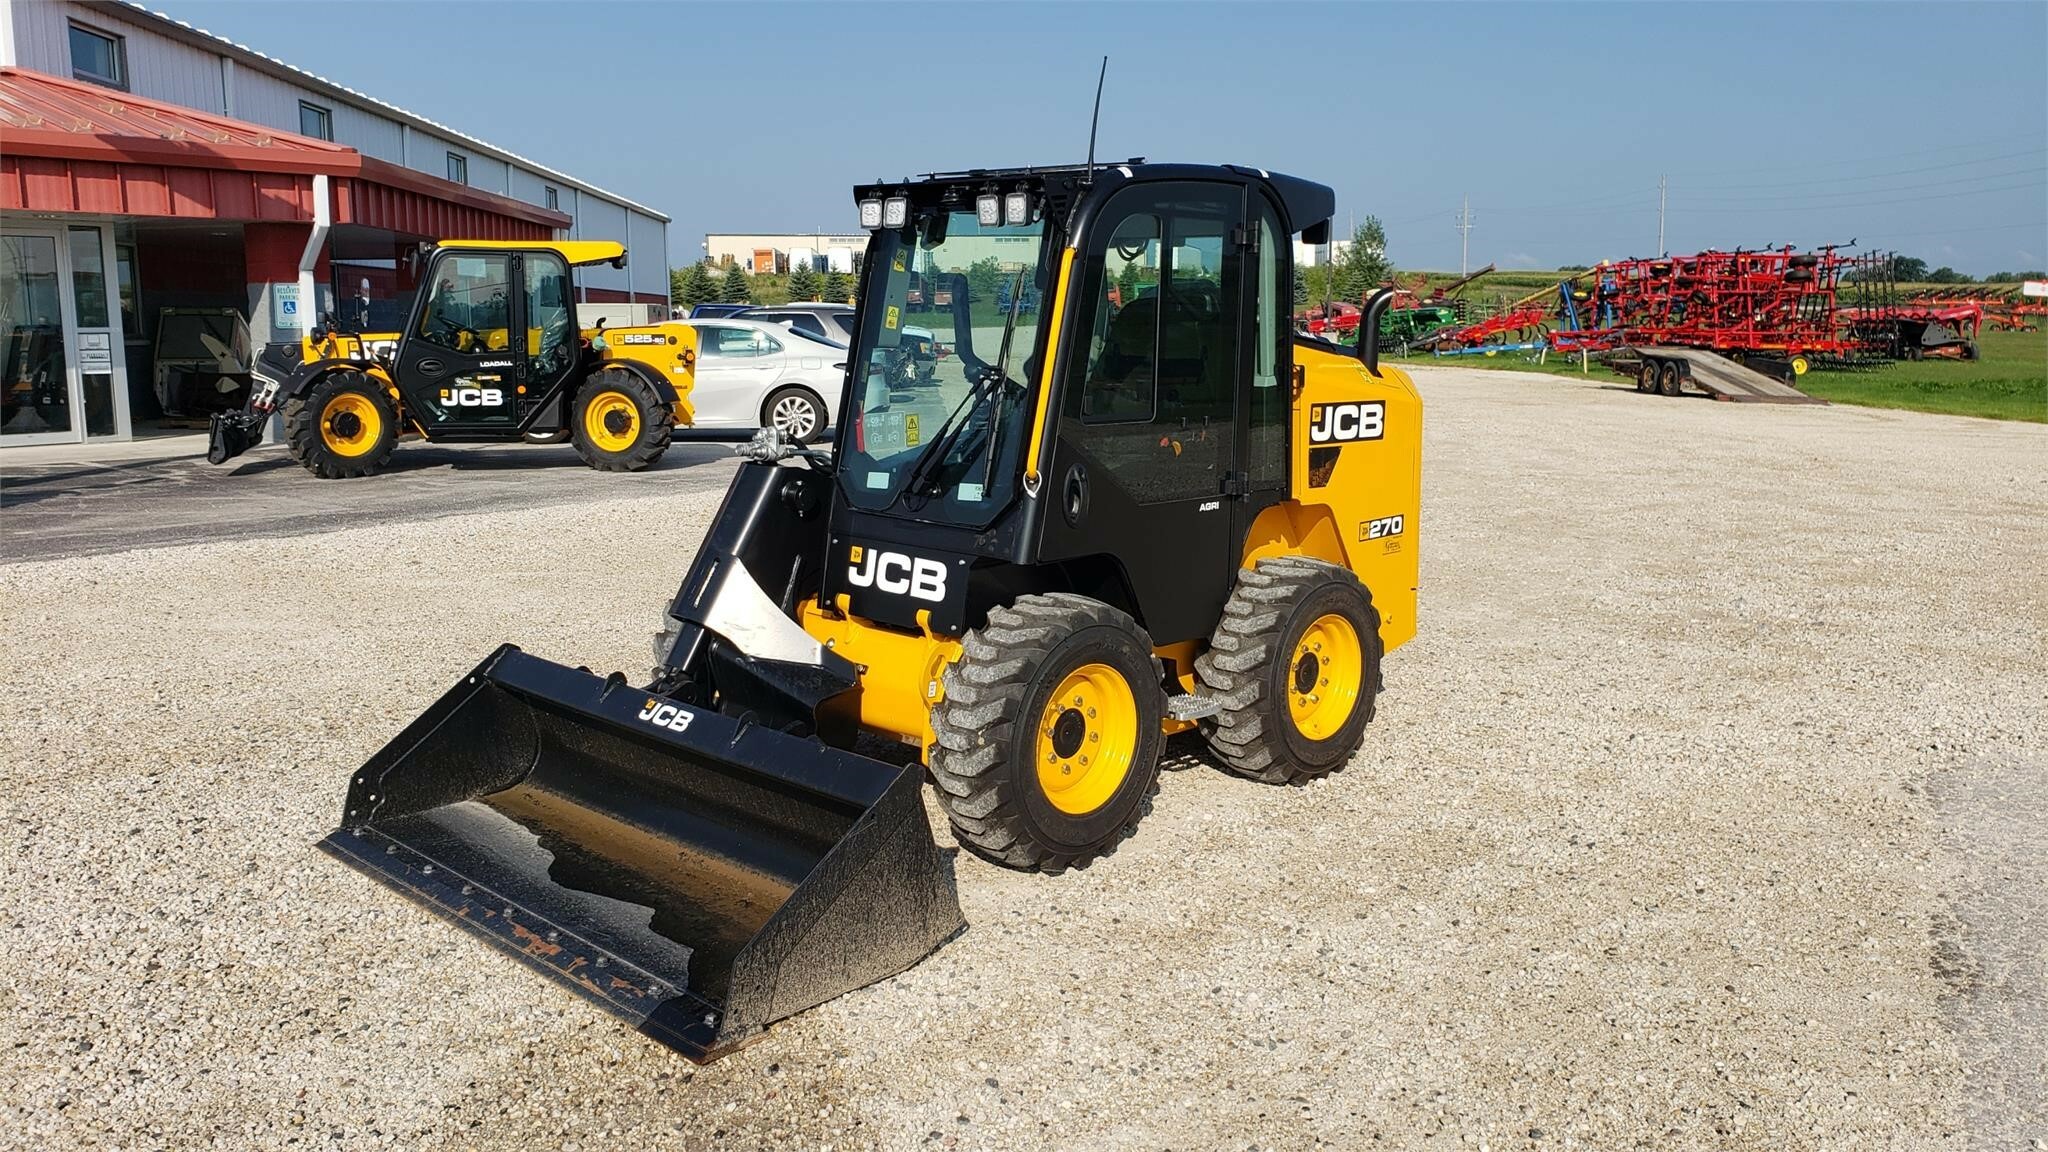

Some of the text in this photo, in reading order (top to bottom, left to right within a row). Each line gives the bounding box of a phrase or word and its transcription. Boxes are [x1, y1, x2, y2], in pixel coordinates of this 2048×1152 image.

[349, 340, 397, 360] JC
[440, 388, 503, 406] JCB
[1310, 403, 1384, 442] JCB
[1199, 501, 1220, 512] AGRI
[1369, 516, 1403, 539] 270
[848, 547, 948, 602] JCB
[638, 701, 694, 732] JCB
